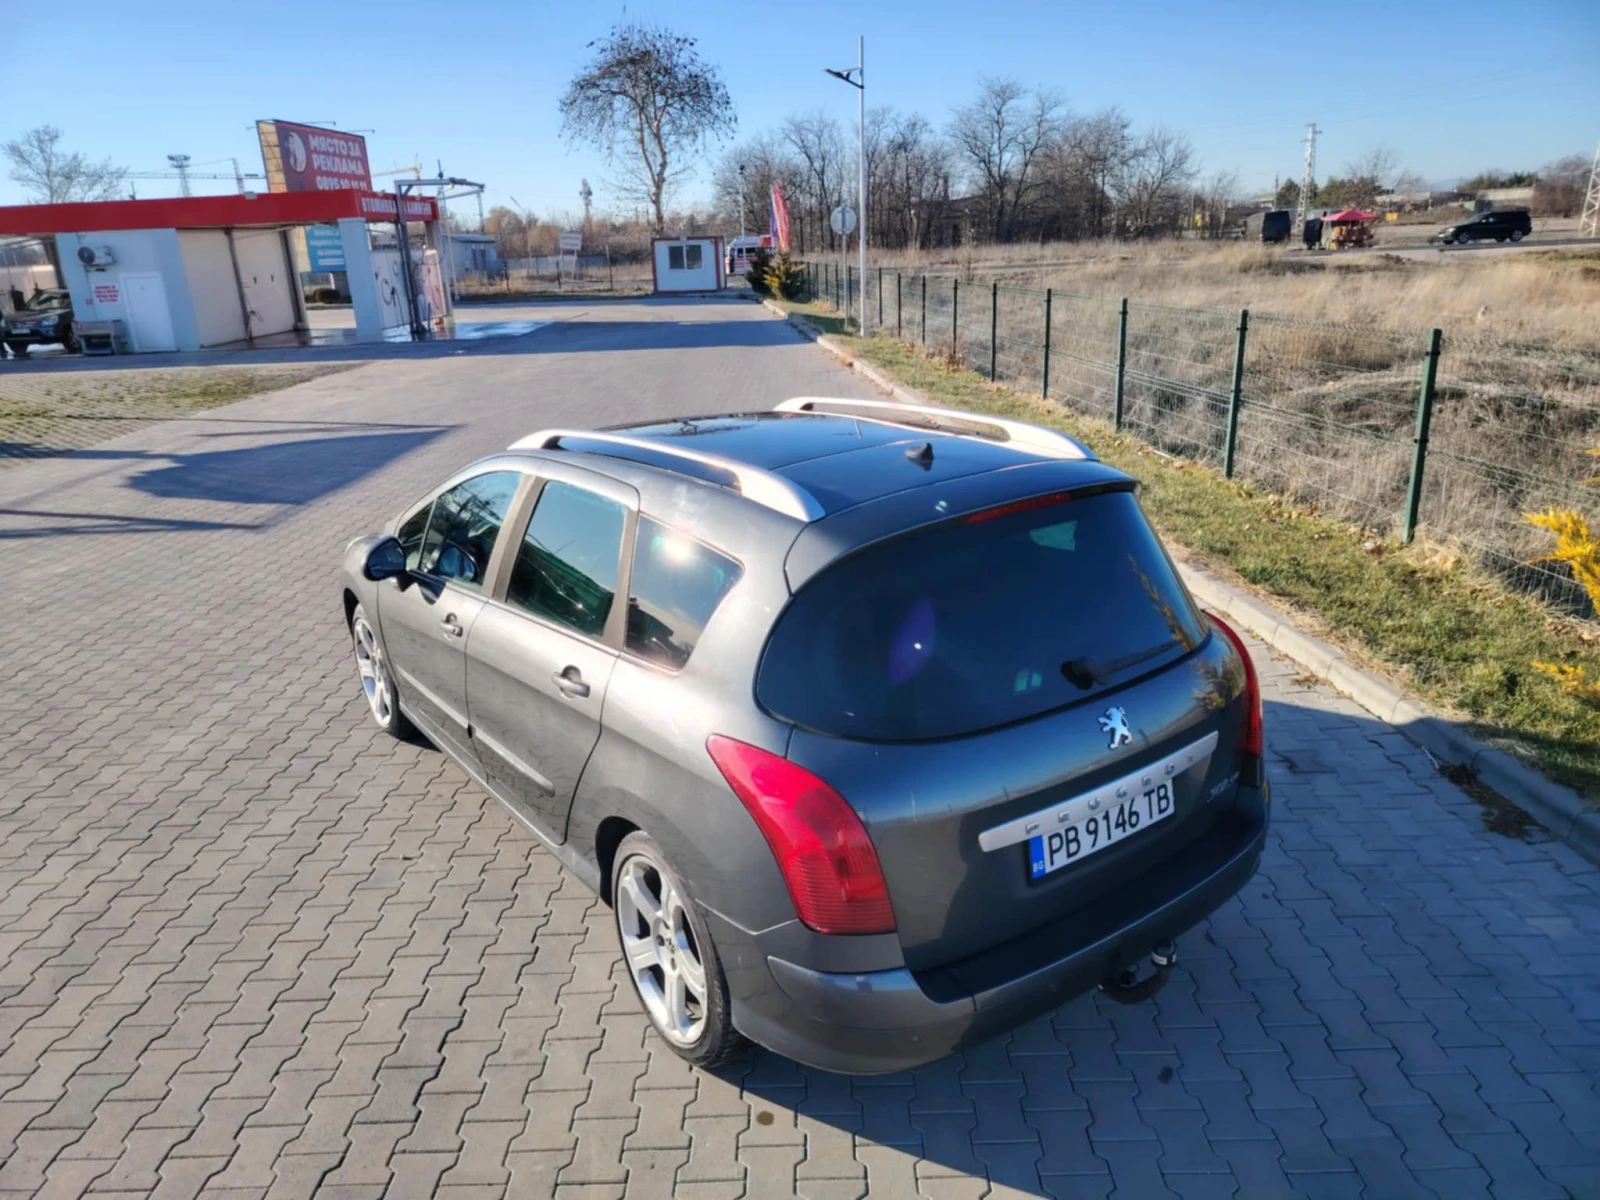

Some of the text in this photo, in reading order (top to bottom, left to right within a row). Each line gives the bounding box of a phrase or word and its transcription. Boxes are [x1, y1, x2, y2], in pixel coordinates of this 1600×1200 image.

[308, 134, 362, 158] МЯСТО ЗА
[312, 153, 365, 176] РЕКЛАМА
[1047, 783, 1170, 867] PB 9146 TB
[1032, 860, 1044, 873] BG
